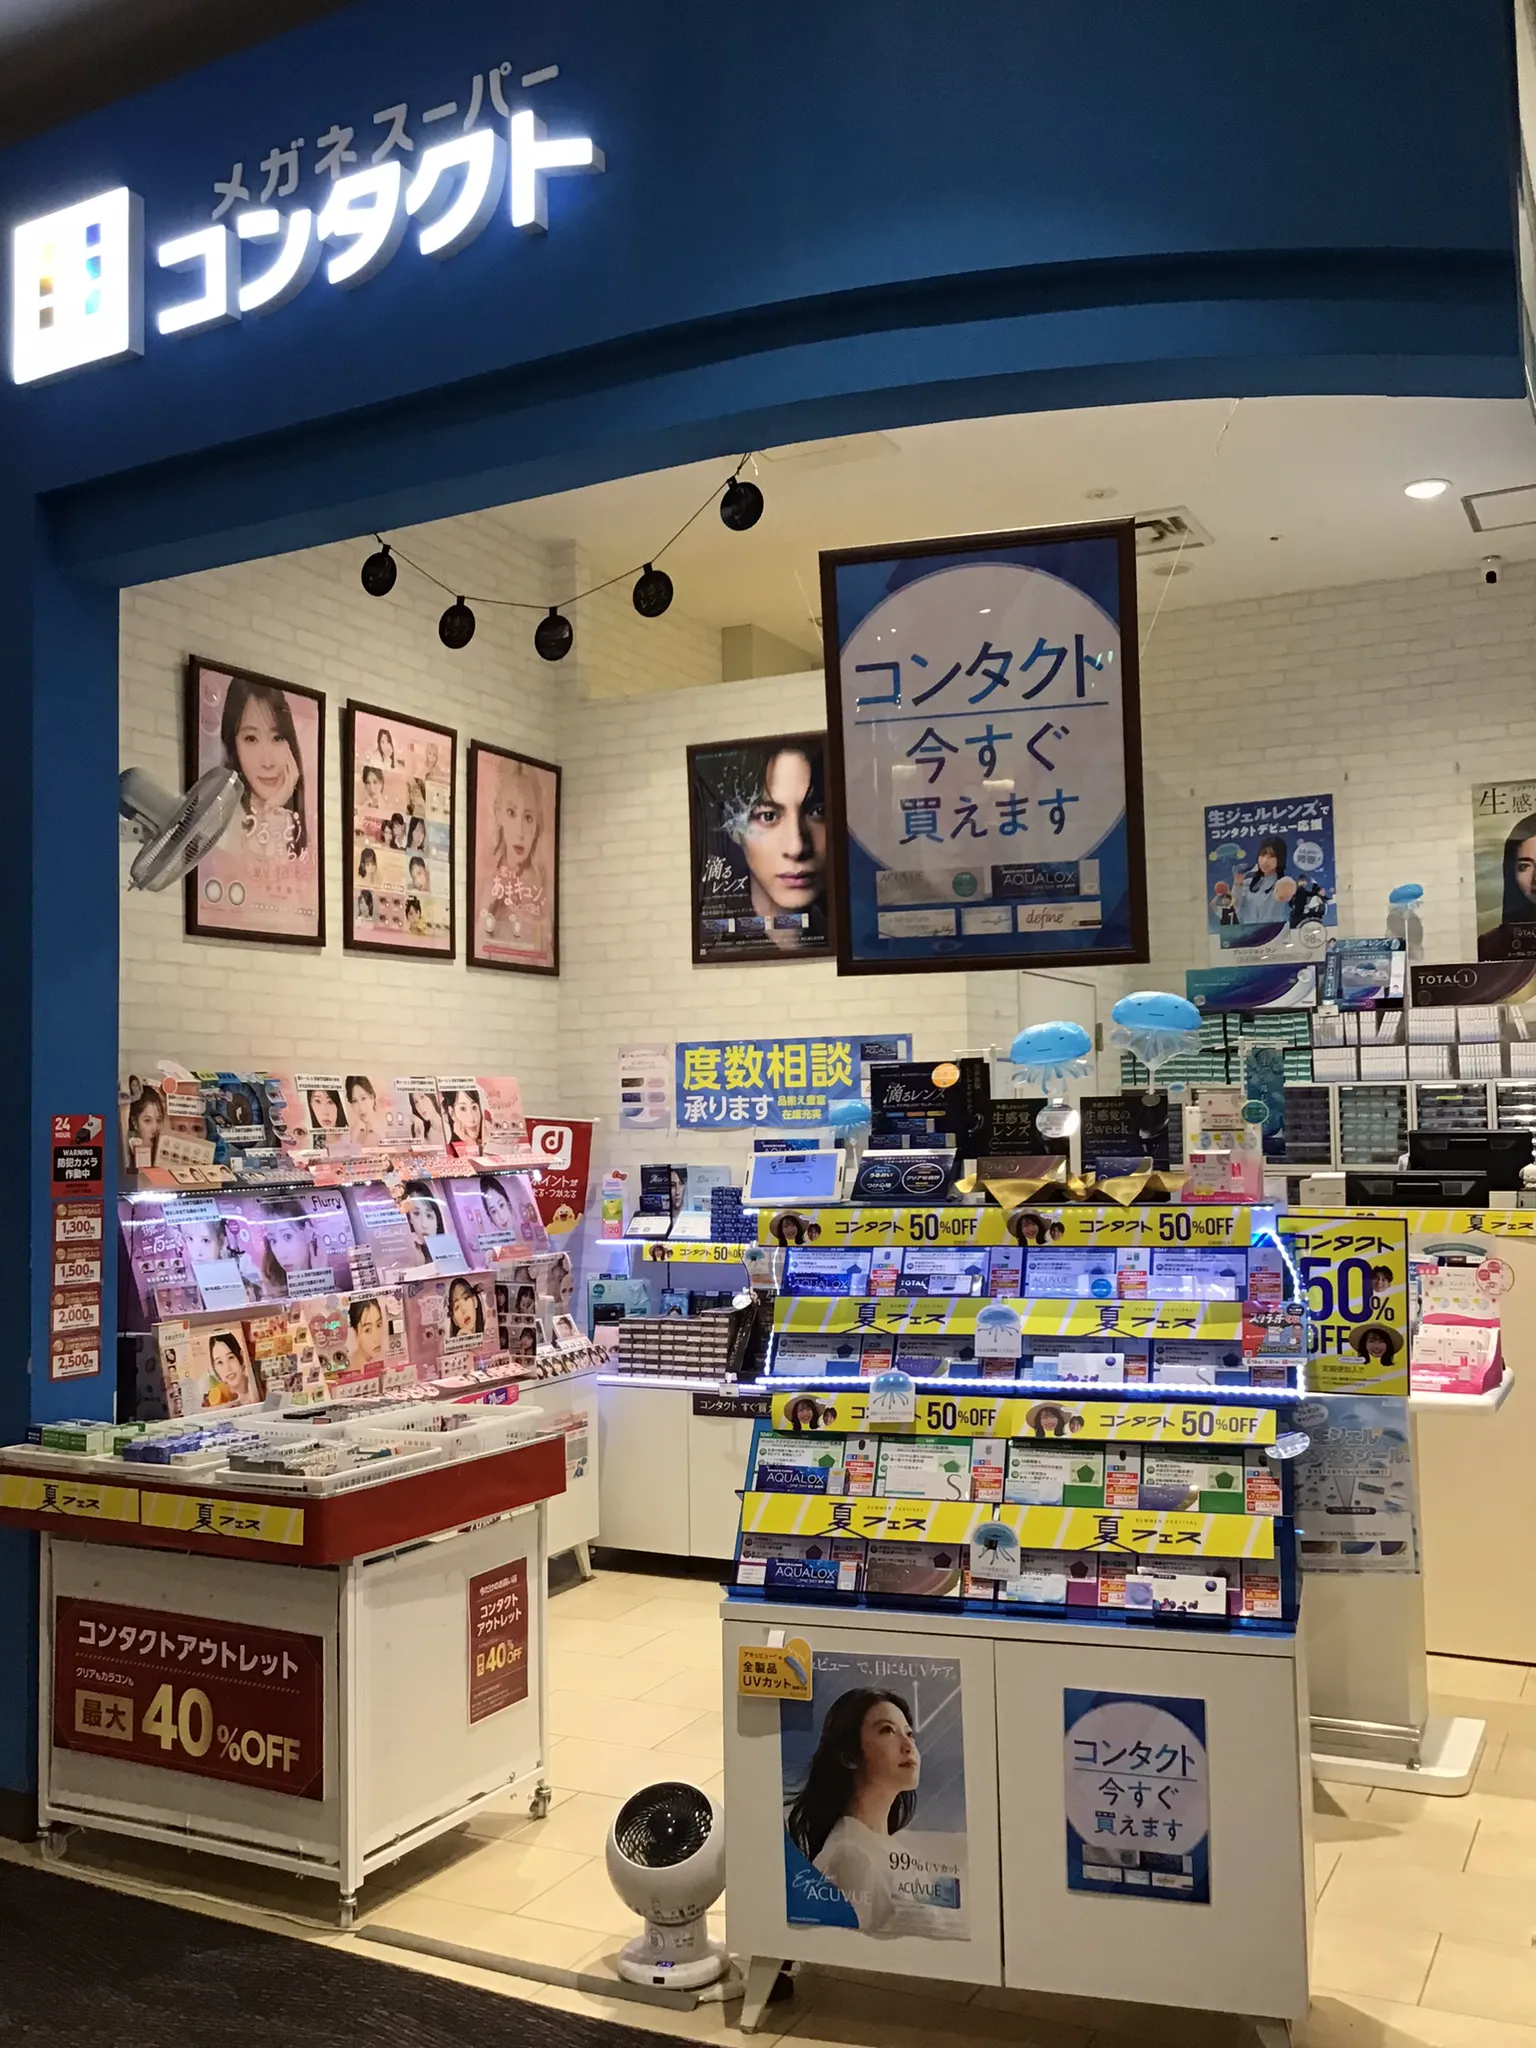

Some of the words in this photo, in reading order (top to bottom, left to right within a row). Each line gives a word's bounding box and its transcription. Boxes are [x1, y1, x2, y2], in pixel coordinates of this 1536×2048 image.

[212, 61, 559, 221] メガネスーパー
[158, 109, 597, 335] コンタクト
[854, 633, 1104, 708] コンタクト
[905, 722, 1069, 783] 今すぐ
[1207, 799, 1330, 828] 生ジェルレンズで
[1478, 787, 1536, 816] 生感
[898, 787, 1079, 845] 買えます
[1211, 818, 1323, 839] コンタクトデビュー応援
[702, 856, 733, 883] 滴る
[1003, 871, 1076, 886] AQUALOX
[712, 875, 749, 893] レンズ
[1026, 907, 1064, 929] define
[1418, 974, 1459, 985] TOTAL
[682, 1041, 853, 1091] 度数相談
[882, 1081, 946, 1104] 滴るレンズ
[683, 1094, 774, 1123] 承ります
[992, 1111, 1031, 1125] 生感覚
[1085, 1110, 1130, 1121] 生感覚の
[55, 1117, 71, 1131] 24
[992, 1126, 1030, 1137] レンズ
[1085, 1122, 1130, 1135] 2week
[540, 1130, 564, 1155] d
[57, 1157, 99, 1168] 防犯カメラ
[65, 1169, 91, 1179] 作動中
[311, 1195, 342, 1212] Flurry
[835, 1221, 904, 1233] コンタクト
[910, 1213, 978, 1241] 50%OFF
[1079, 1220, 1153, 1234] コンタクト
[1159, 1212, 1234, 1242] 50%OFF
[1462, 1214, 1535, 1234] 夏フェス
[679, 1248, 711, 1256] コンタクト
[1290, 1233, 1395, 1253] コンタクト
[900, 1279, 928, 1288] TOTAL
[1300, 1257, 1395, 1323] 50%
[841, 1303, 946, 1335] 夏フェス
[1082, 1305, 1197, 1338] 夏フェス
[700, 1400, 737, 1410] コンタクト
[927, 1401, 997, 1430] 50%OFF
[1100, 1414, 1176, 1428] コンタクト
[1181, 1410, 1259, 1437] 50%OFF
[766, 1472, 824, 1485] AQUALOX
[35, 1484, 100, 1514] 夏フェス
[188, 1503, 260, 1535] 夏フェス
[813, 1502, 926, 1538] 夏フェス
[1079, 1514, 1202, 1553] 夏フェス
[774, 1565, 837, 1579] AQUALOX
[480, 1593, 519, 1619] コンタクト
[477, 1608, 522, 1637] アウトレット
[78, 1620, 299, 1680] コンタクトアウトレット
[485, 1642, 507, 1673] 40
[506, 1647, 523, 1664] OFF
[75, 1667, 134, 1687] クリアもカラコンも
[742, 1661, 778, 1675] 全製品
[742, 1675, 792, 1689] UVカット
[82, 1698, 126, 1733] 最大
[141, 1683, 300, 1773] 40%OFF
[1073, 1739, 1196, 1777] コンタクト
[1098, 1776, 1180, 1810] 今すぐ
[1094, 1810, 1183, 1842] 買えます
[888, 1851, 924, 1872] 99%
[806, 1886, 874, 1905] ACUVUE
[897, 1880, 942, 1897] ACUVUE
